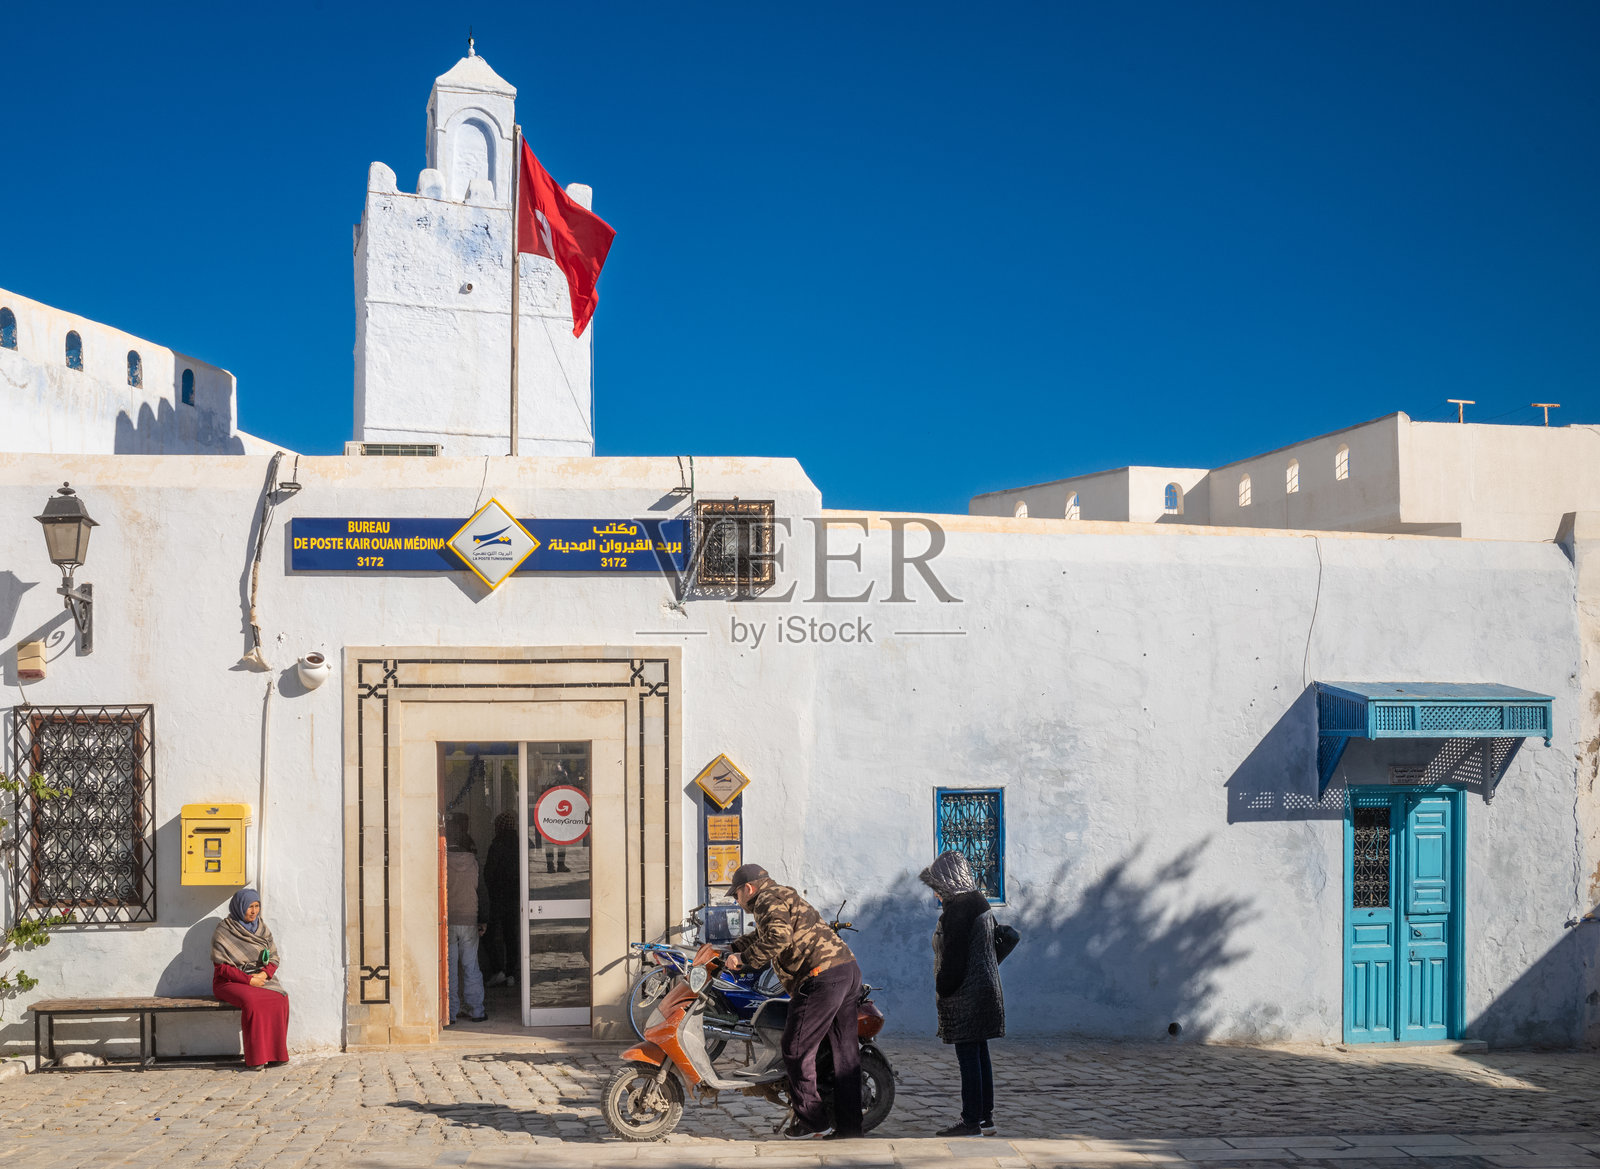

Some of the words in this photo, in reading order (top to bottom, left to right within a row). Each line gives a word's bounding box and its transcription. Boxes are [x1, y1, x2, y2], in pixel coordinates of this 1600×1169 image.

[348, 521, 390, 533] BUREAU
[593, 523, 637, 537] مكتب
[293, 537, 308, 549] DE
[310, 537, 344, 549] POSTE
[345, 537, 402, 550] KAIROUAN
[404, 536, 446, 550] MÉDINA
[548, 539, 596, 553] المدينة
[599, 539, 652, 553] القيروان
[656, 541, 682, 553] بريد
[357, 556, 384, 567] 3172
[600, 557, 627, 567] 3172
[543, 817, 584, 826] MoneyGram
